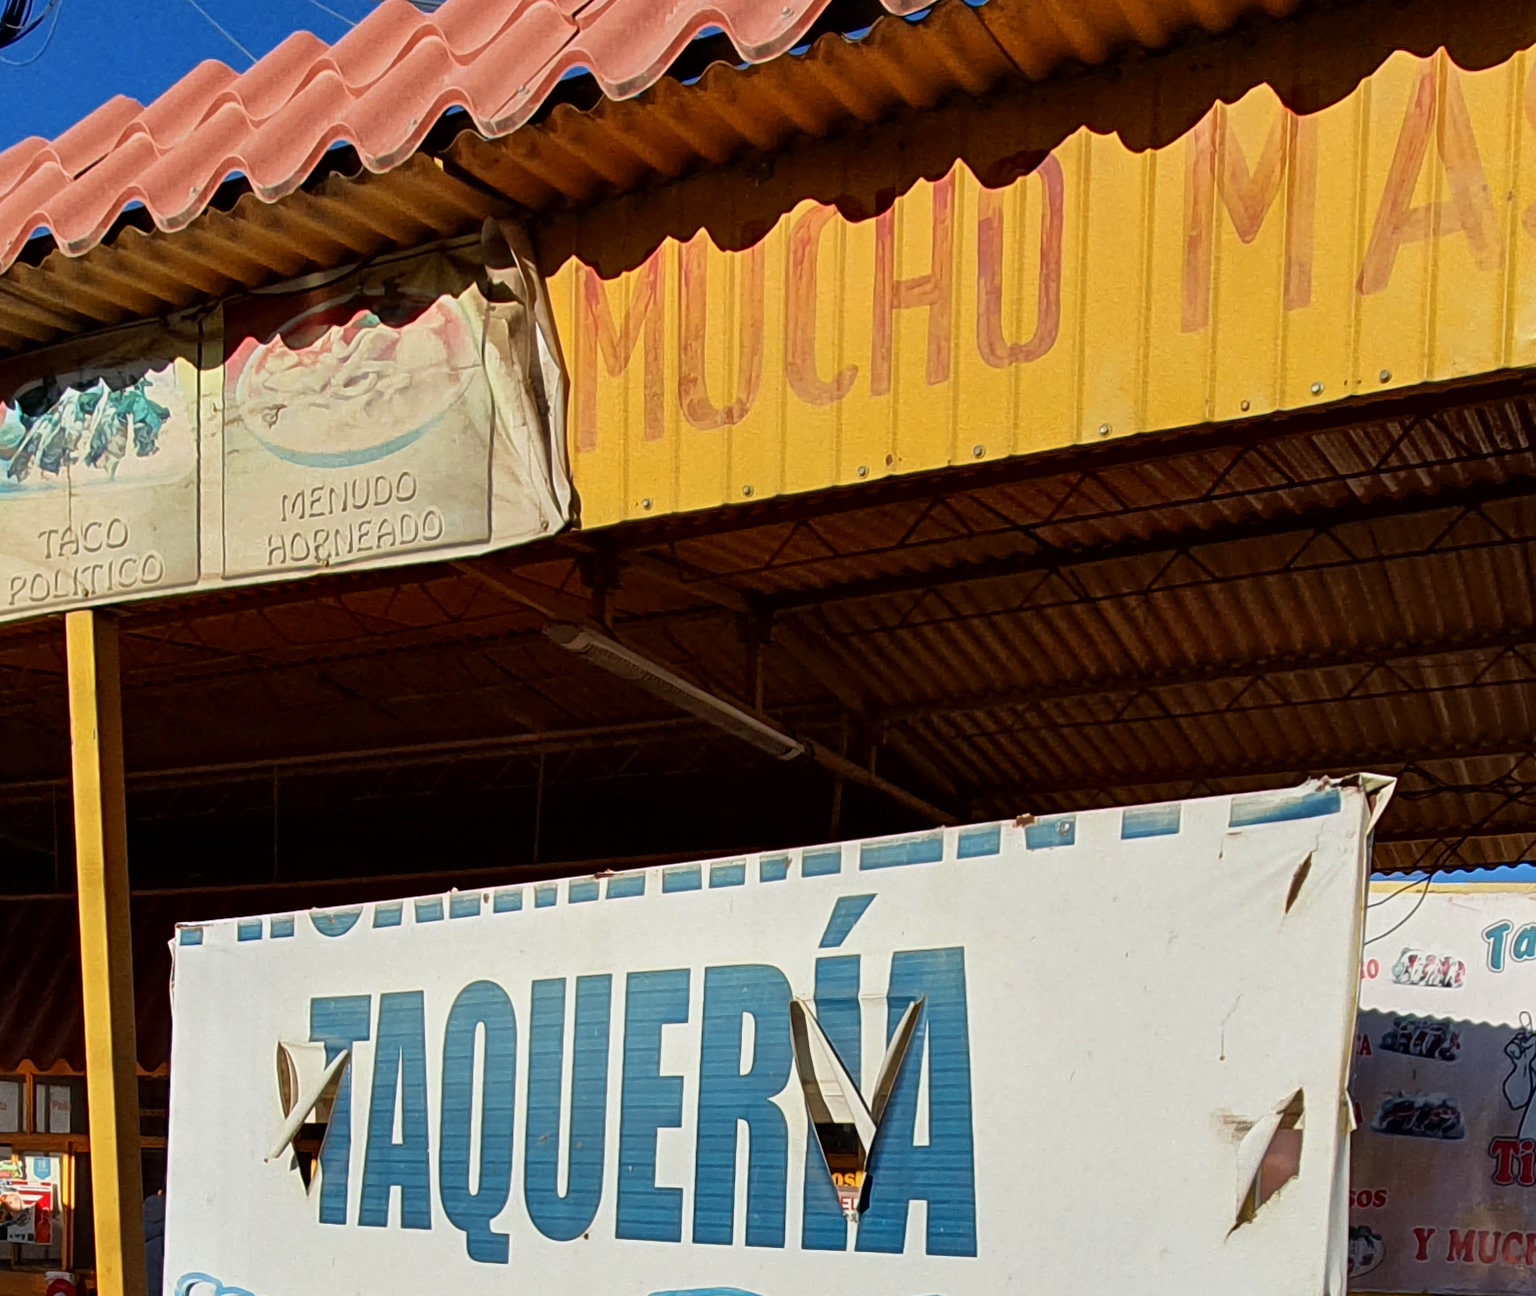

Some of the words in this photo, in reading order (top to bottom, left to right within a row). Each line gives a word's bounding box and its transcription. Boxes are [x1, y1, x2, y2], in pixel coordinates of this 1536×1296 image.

[576, 156, 1063, 453] MUCHO
[279, 470, 419, 522] MENUDO
[38, 517, 130, 561] TACO
[266, 509, 445, 567] HORNEADO
[309, 892, 978, 1266] TAQUERÍA
[1413, 1227, 1435, 1262] Y
